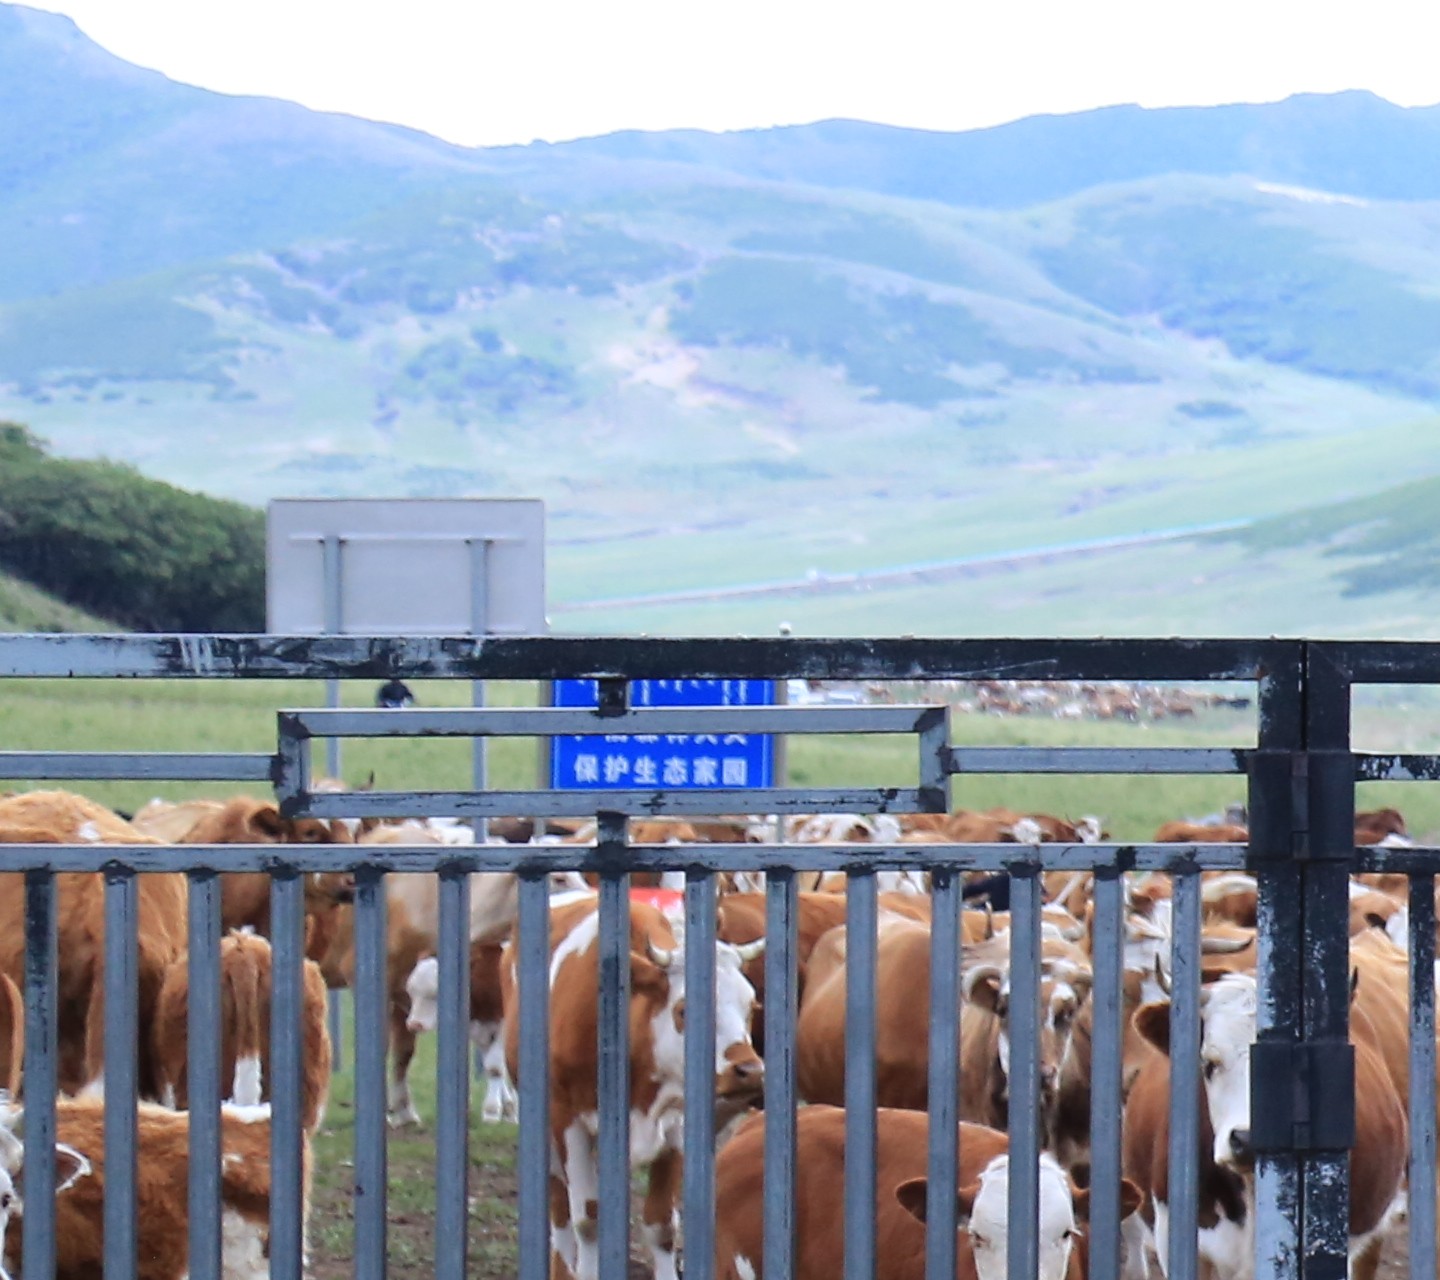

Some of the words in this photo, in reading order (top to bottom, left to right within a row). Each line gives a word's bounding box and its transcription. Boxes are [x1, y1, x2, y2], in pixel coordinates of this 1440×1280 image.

[573, 754, 748, 786] 保护生态家园
